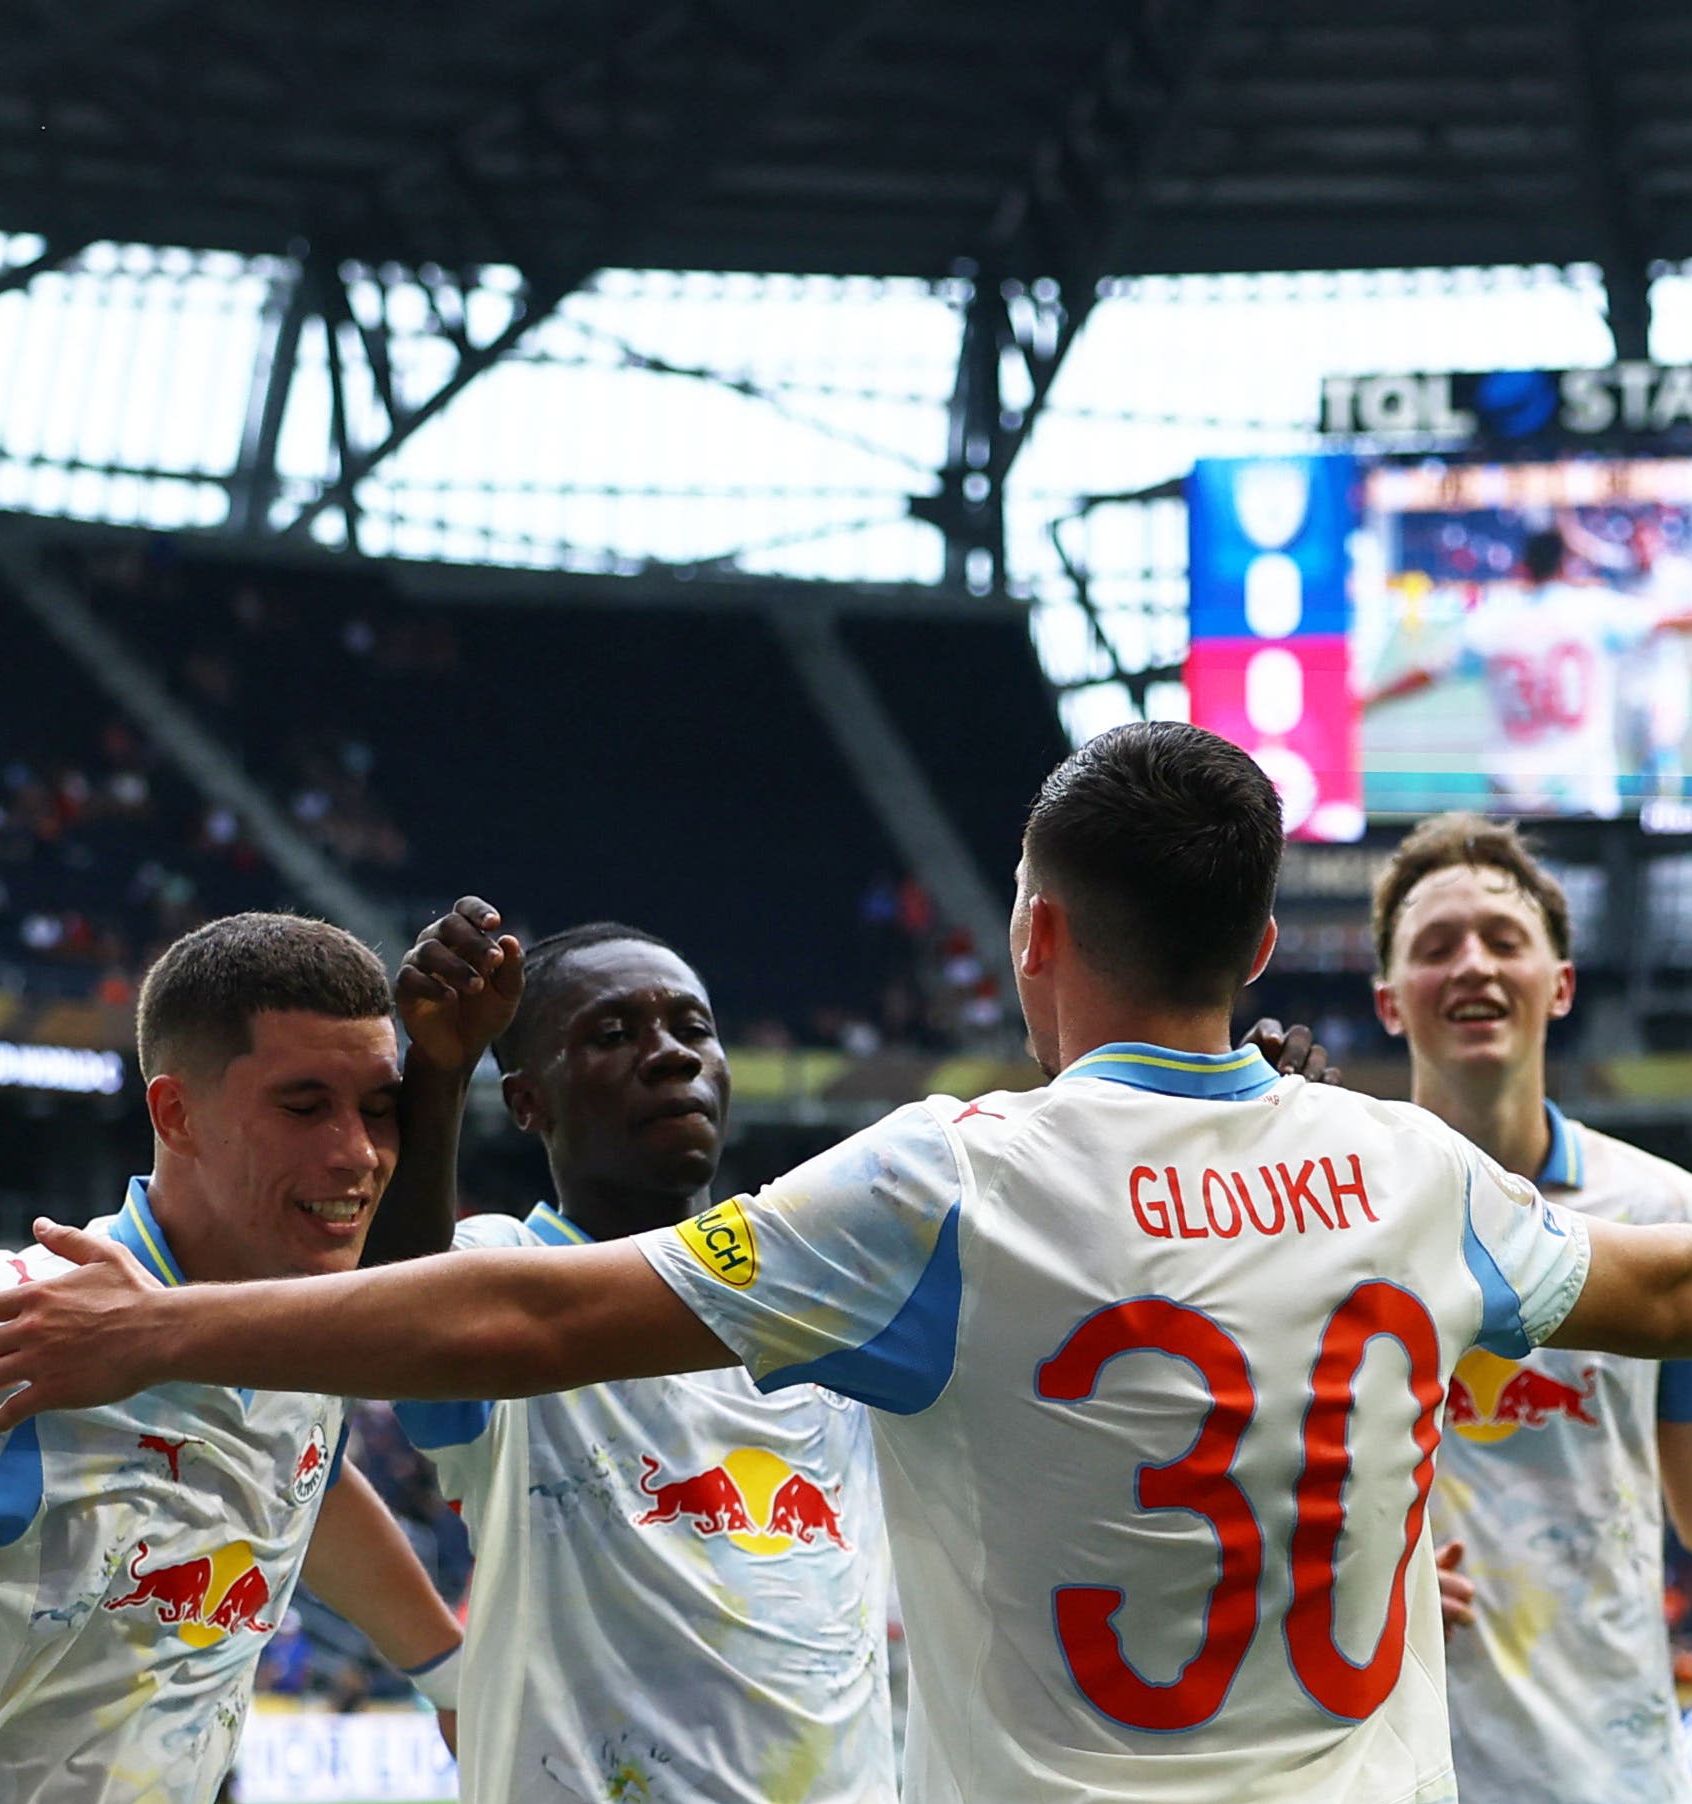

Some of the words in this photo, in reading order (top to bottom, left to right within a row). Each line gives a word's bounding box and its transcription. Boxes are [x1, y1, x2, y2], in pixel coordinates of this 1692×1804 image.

[1129, 1153, 1380, 1239] GLOUKH
[695, 1208, 749, 1272] UCH
[1034, 1278, 1444, 1734] 30
